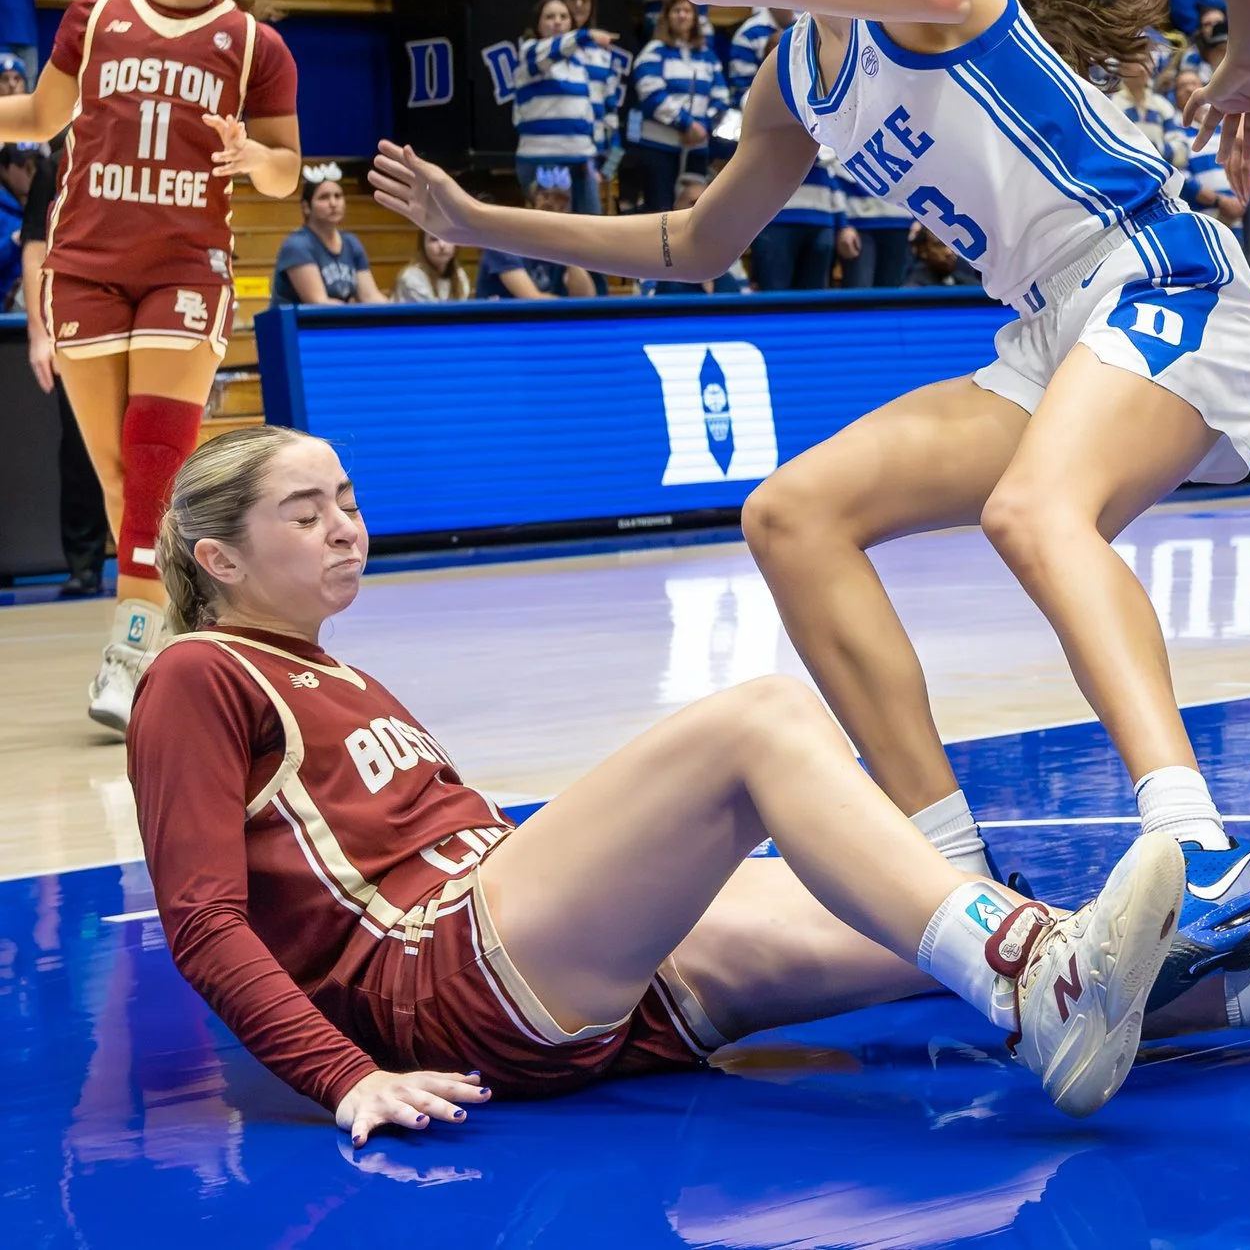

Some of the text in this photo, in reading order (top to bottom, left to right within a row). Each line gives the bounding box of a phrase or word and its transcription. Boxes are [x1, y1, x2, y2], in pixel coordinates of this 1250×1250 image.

[99, 57, 224, 114] BOSTON
[405, 36, 453, 108] D
[137, 100, 172, 161] 11
[841, 105, 936, 197] UKE
[88, 162, 210, 208] COLLEGE
[906, 186, 988, 262] 3
